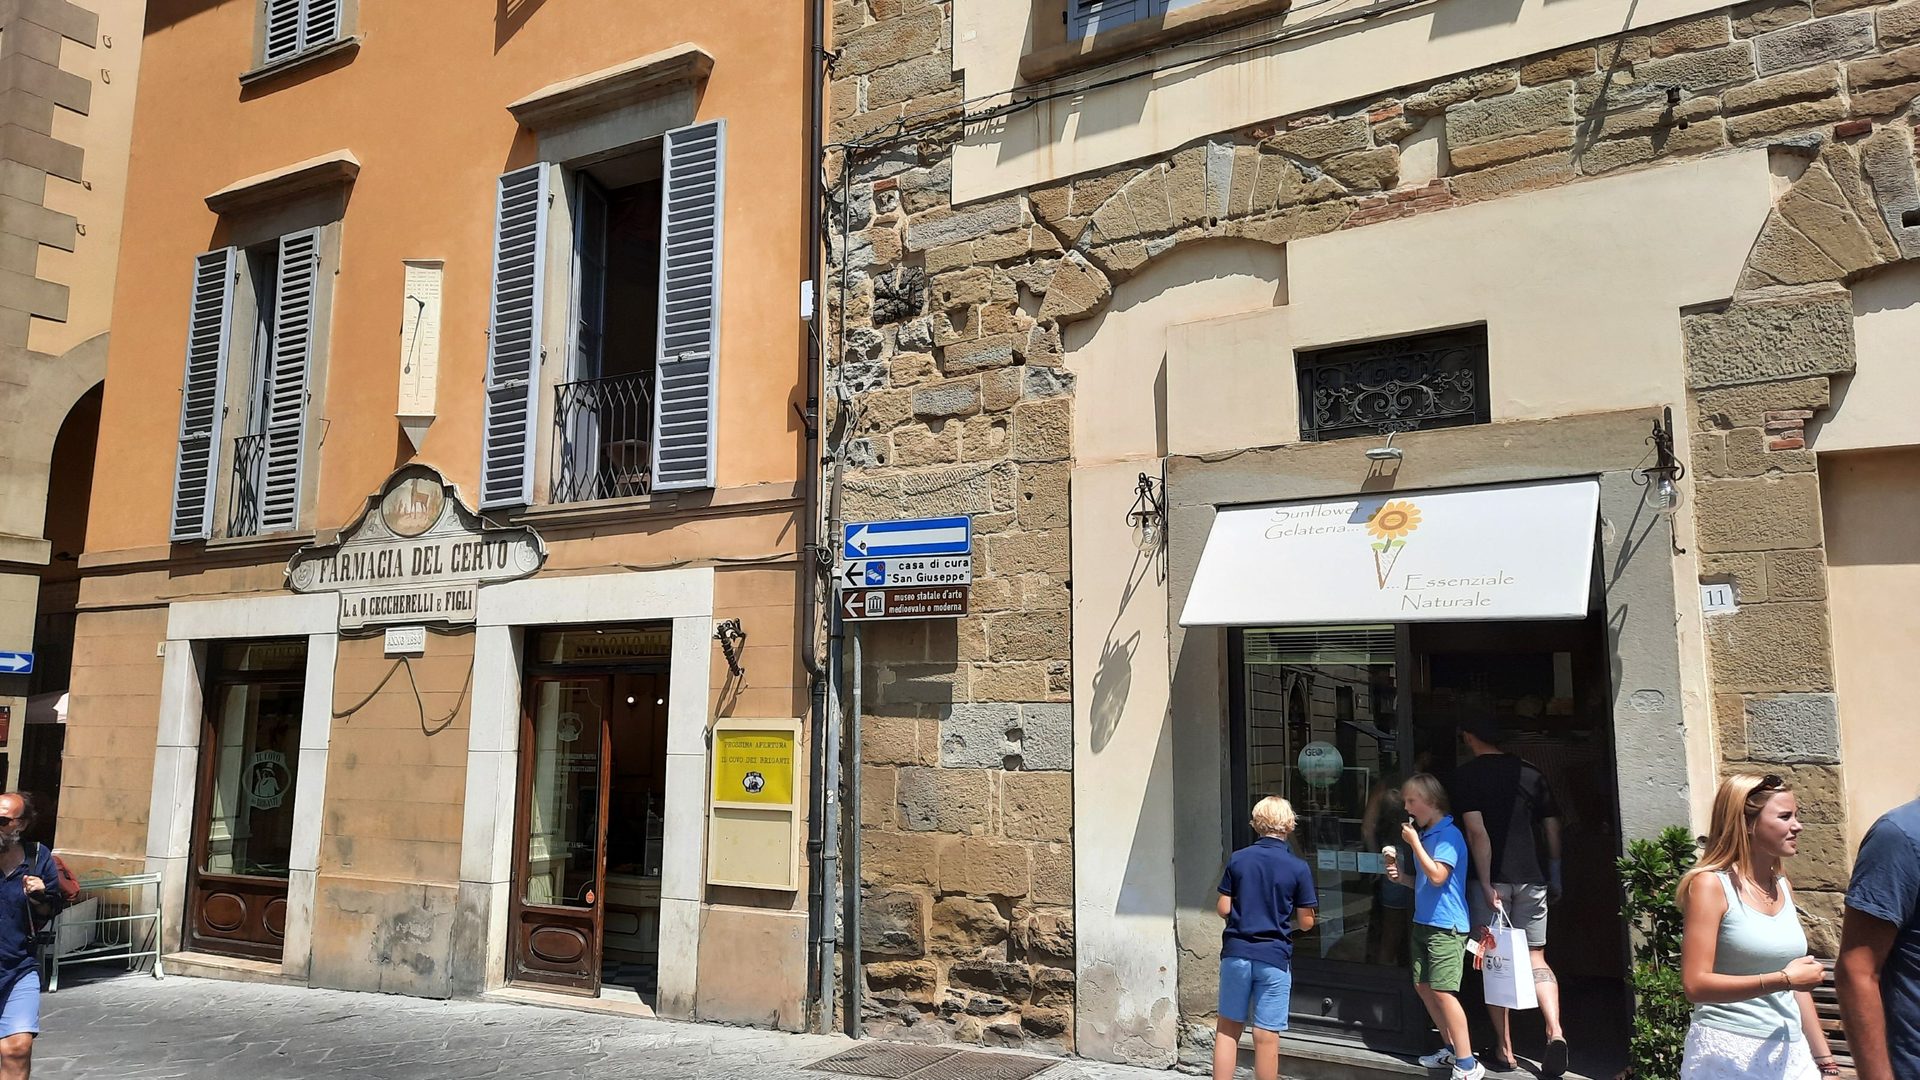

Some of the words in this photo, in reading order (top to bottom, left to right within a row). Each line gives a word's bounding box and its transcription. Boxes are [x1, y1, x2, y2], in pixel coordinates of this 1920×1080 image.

[1270, 504, 1364, 523] Sunflower
[318, 547, 404, 584] FARMACIA
[411, 544, 443, 576] DEL
[450, 539, 508, 574] CERVO
[898, 562, 925, 571] casa
[929, 558, 939, 569] di
[944, 559, 969, 568] cura
[887, 572, 912, 583] "San
[916, 570, 970, 584] Giuseppe"
[343, 598, 351, 617] L.
[352, 603, 357, 617] &
[369, 592, 434, 616] CECCHERELLI
[445, 590, 473, 611] FIGLI
[894, 594, 915, 602] museo
[916, 590, 940, 601] statale
[942, 589, 963, 599] d'arte
[1401, 591, 1492, 611] Naturale
[1706, 589, 1727, 606] 11
[888, 603, 925, 614] medioevale
[927, 603, 931, 611] e
[933, 601, 962, 612] moderna
